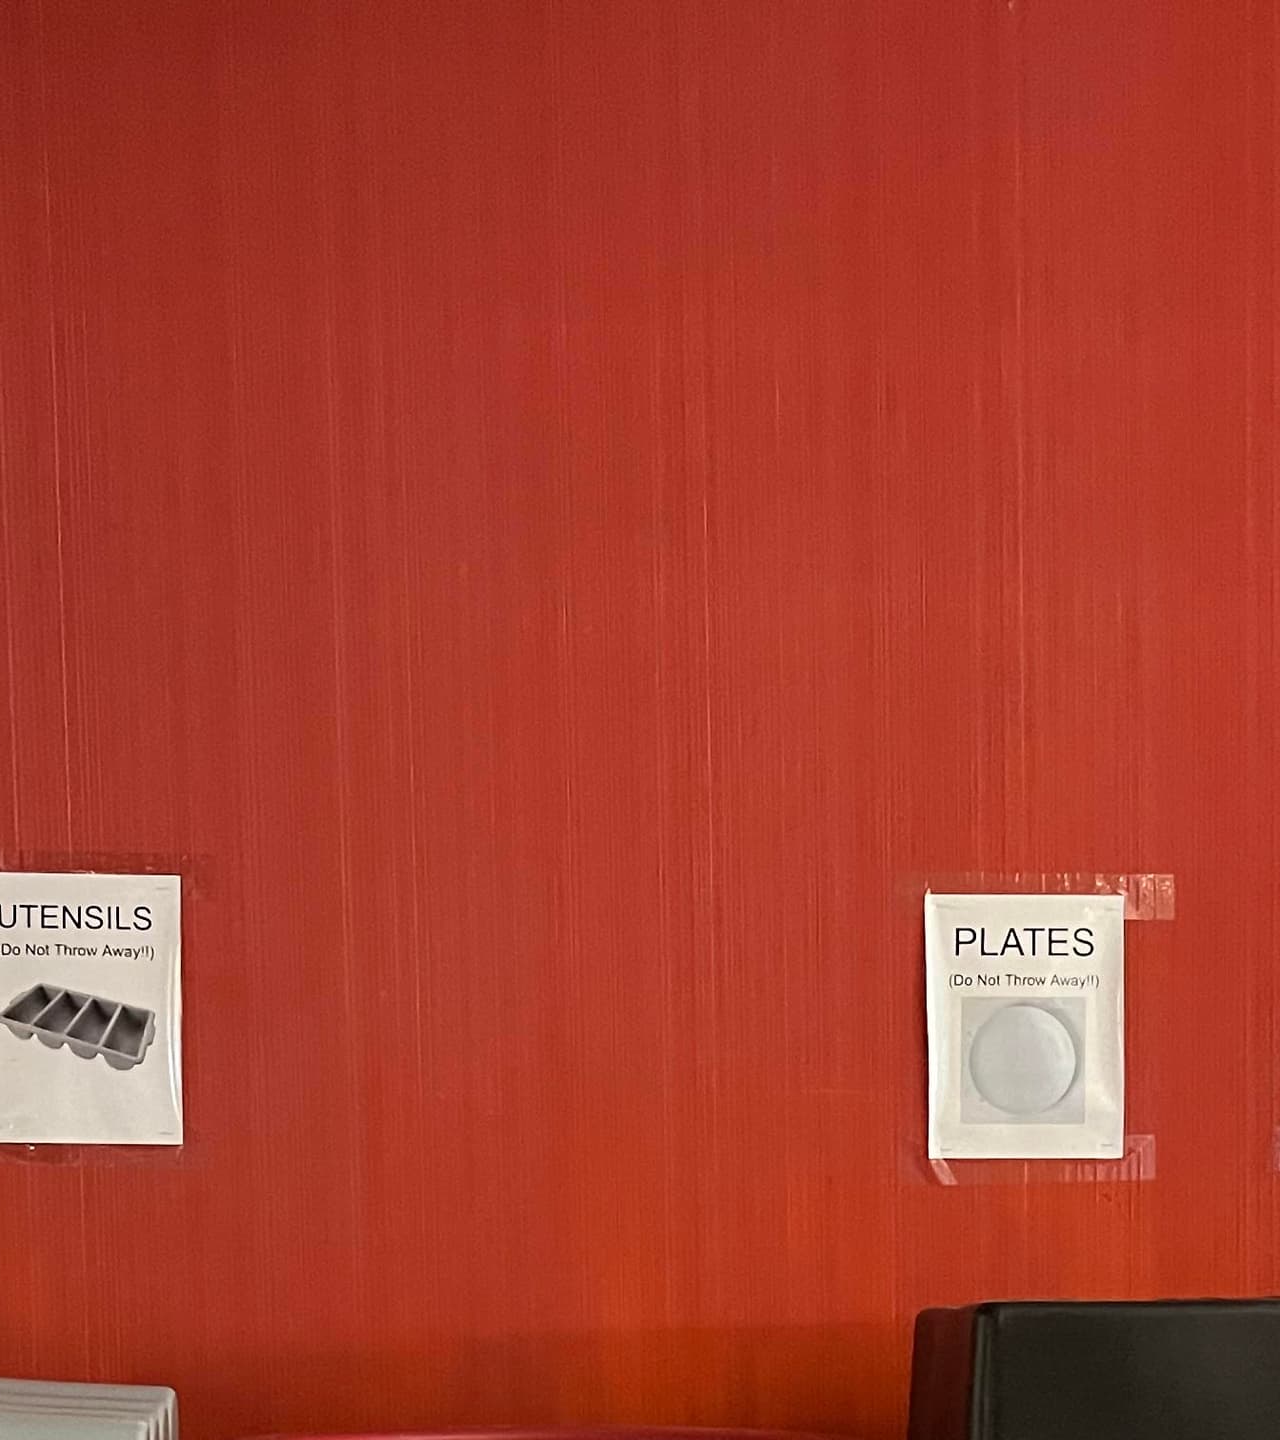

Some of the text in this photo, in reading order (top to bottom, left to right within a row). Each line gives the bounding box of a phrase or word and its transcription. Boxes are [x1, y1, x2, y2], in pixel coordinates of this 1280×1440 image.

[954, 927, 1095, 957] PLATES
[25, 944, 50, 956] Not
[54, 943, 98, 957] Throw
[102, 944, 155, 961] Away!!)
[948, 974, 1100, 989] (Do Not Throw Away!!)
